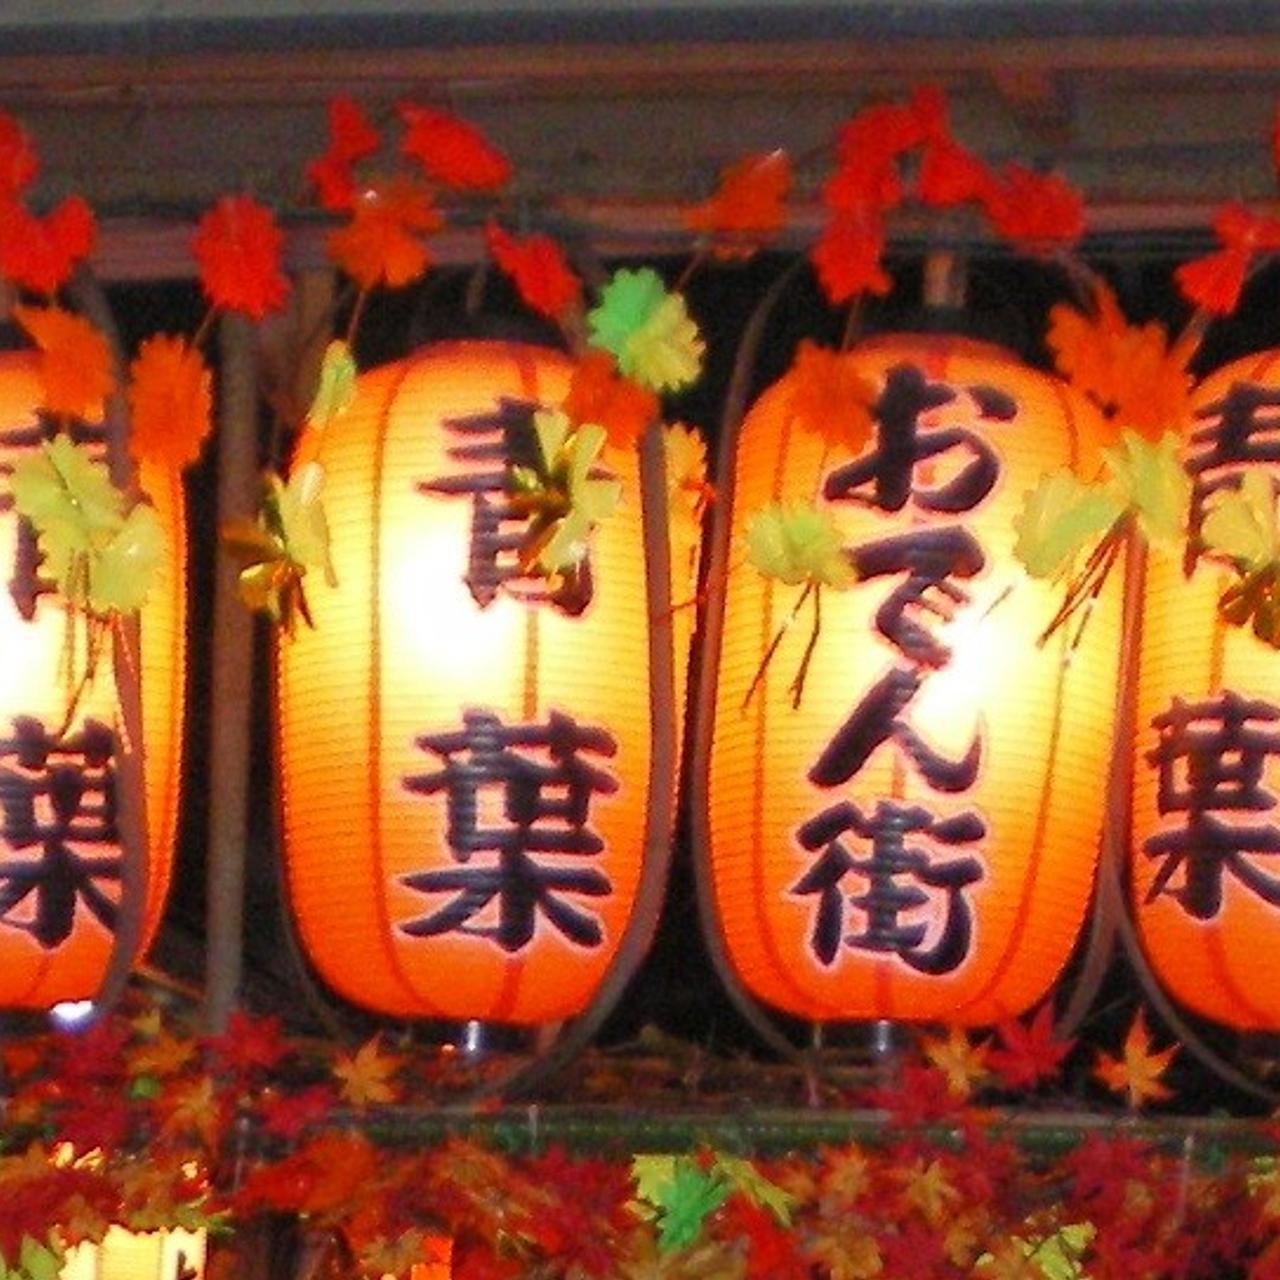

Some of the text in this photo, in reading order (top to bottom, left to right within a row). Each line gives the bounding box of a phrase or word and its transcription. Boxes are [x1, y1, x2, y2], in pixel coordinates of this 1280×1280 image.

[401, 395, 623, 953] 青葉
[788, 363, 1018, 977] おでん街
